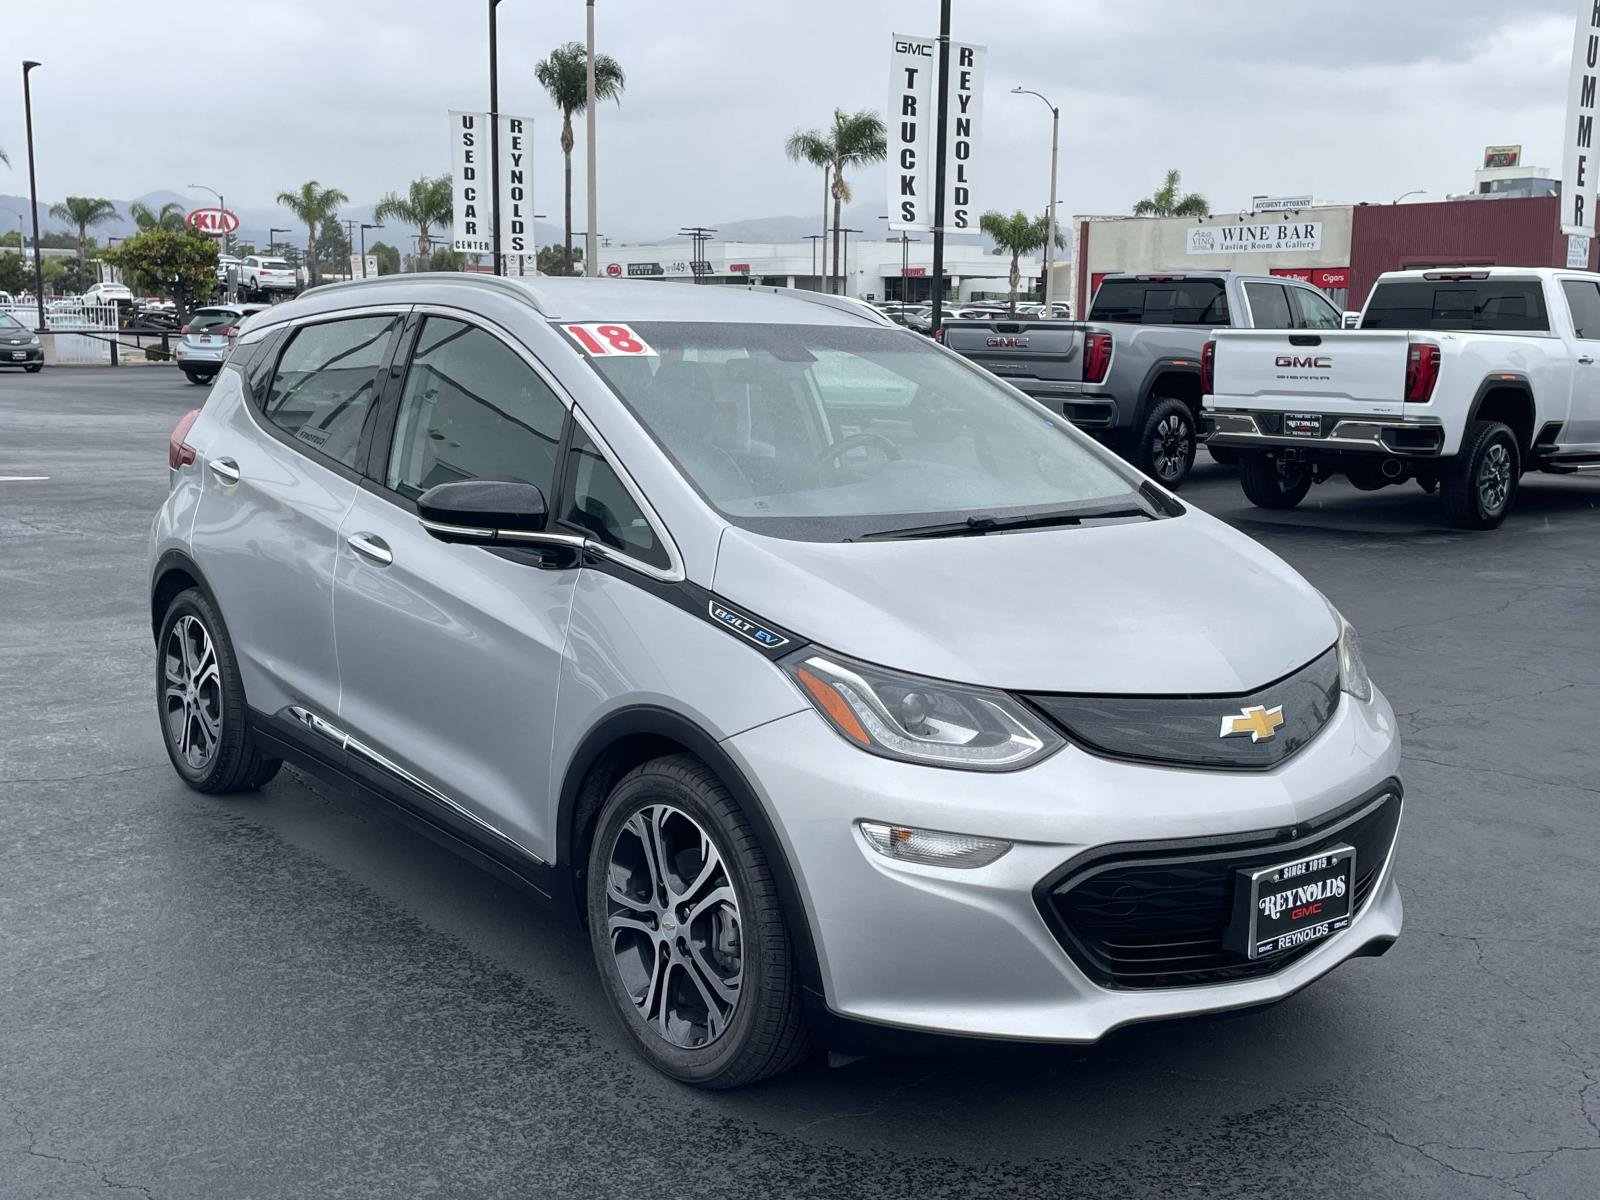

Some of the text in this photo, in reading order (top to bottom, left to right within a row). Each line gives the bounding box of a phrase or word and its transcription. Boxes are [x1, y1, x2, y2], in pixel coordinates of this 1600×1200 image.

[895, 41, 932, 57] GMC
[900, 67, 918, 222] TRUCKS
[954, 46, 974, 229] REYNOLDS
[462, 115, 477, 235] USED CAR
[510, 118, 524, 251] REYNOLDS
[1283, 199, 1311, 207] ATTORNEY
[196, 213, 231, 229] KIA
[1192, 237, 1215, 246] VINO
[1222, 223, 1315, 242] WINE BAR
[455, 240, 490, 251] CENTER
[1220, 240, 1315, 251] Tasting Room & Gallery
[1322, 273, 1345, 284] Cigars
[568, 325, 644, 354] 18
[986, 336, 1029, 348] GMC
[1275, 356, 1332, 368] GMC
[714, 608, 778, 644] BOLT EV
[1283, 857, 1327, 879] SINCE 1915
[1258, 875, 1346, 920] REYNOLDS
[1291, 902, 1322, 920] GMC
[1258, 920, 1348, 953] GMC REYNOLDS GMC
